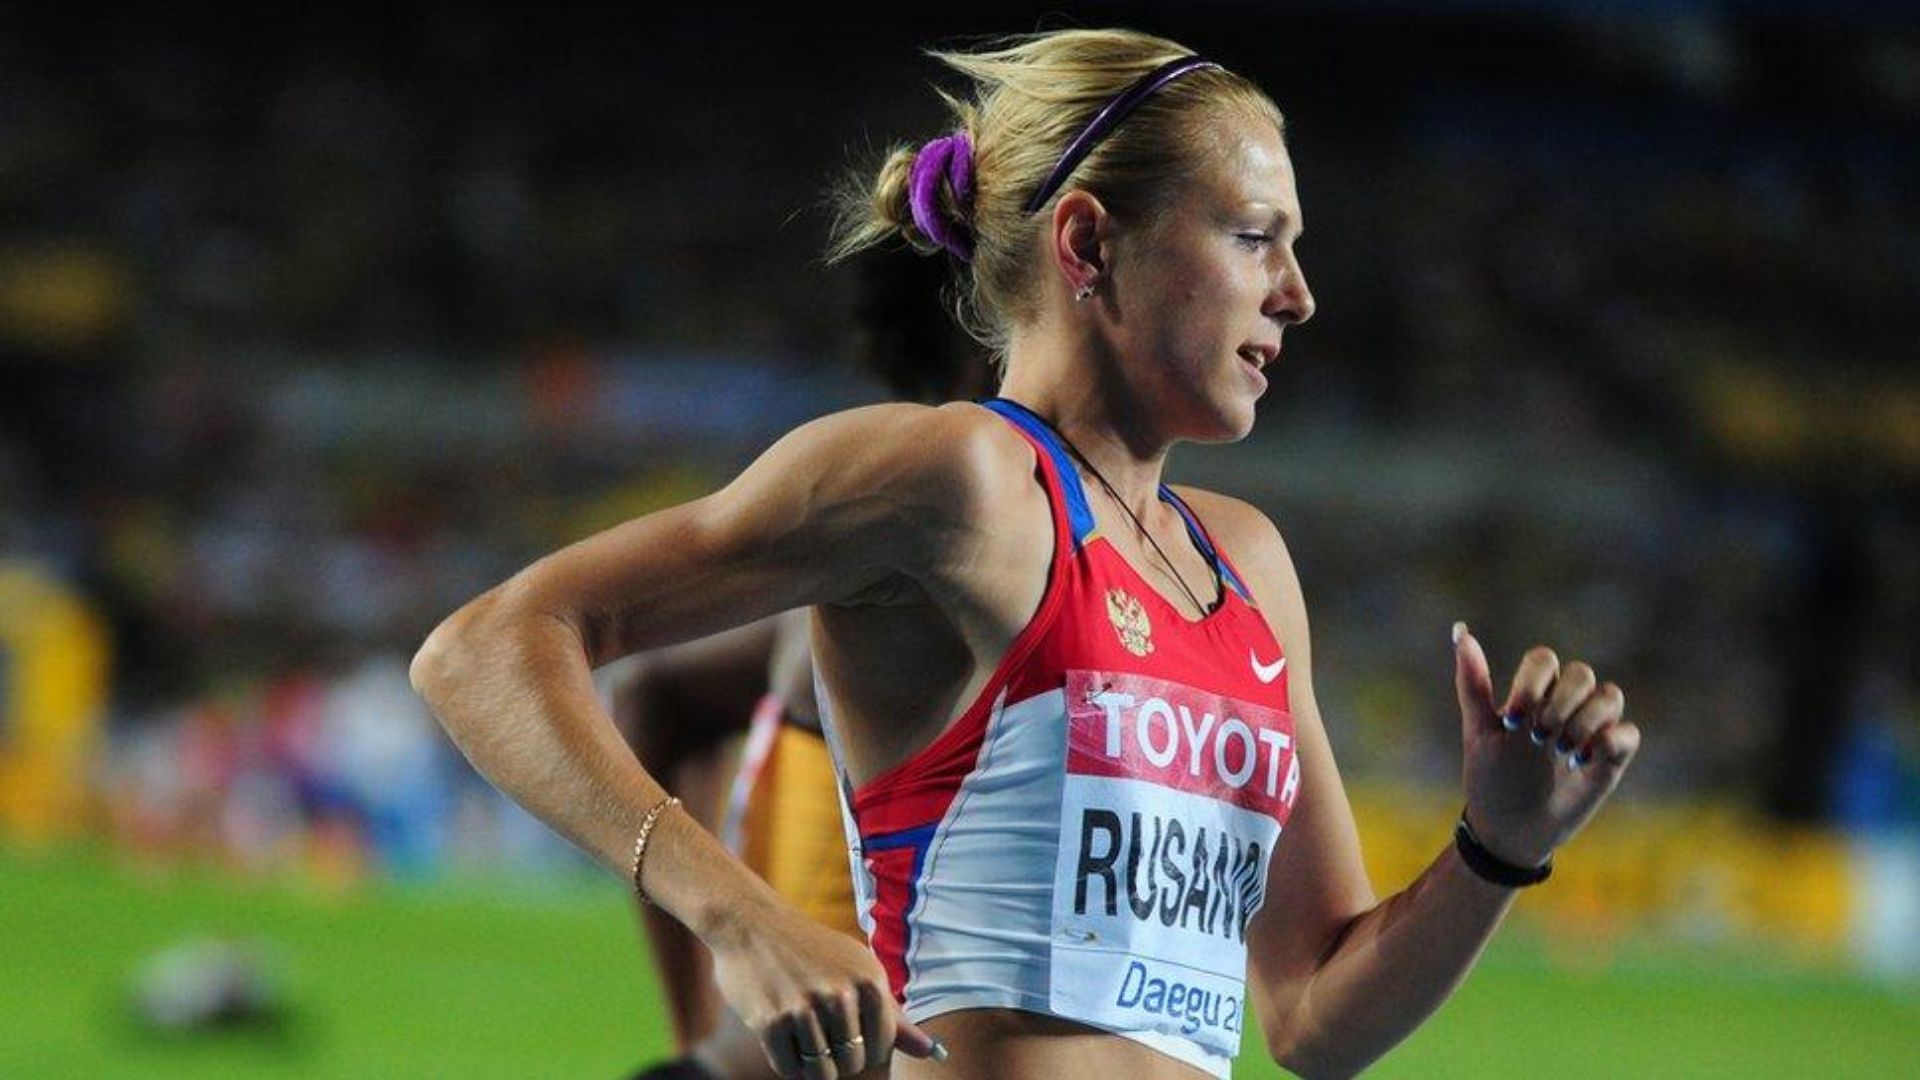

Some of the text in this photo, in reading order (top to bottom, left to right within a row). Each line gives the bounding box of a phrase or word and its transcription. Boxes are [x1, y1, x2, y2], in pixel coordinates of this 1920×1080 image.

[1097, 692, 1300, 808] TOYOTA
[1073, 808, 1262, 945] RUSANO
[1116, 960, 1221, 1034] Daegu
